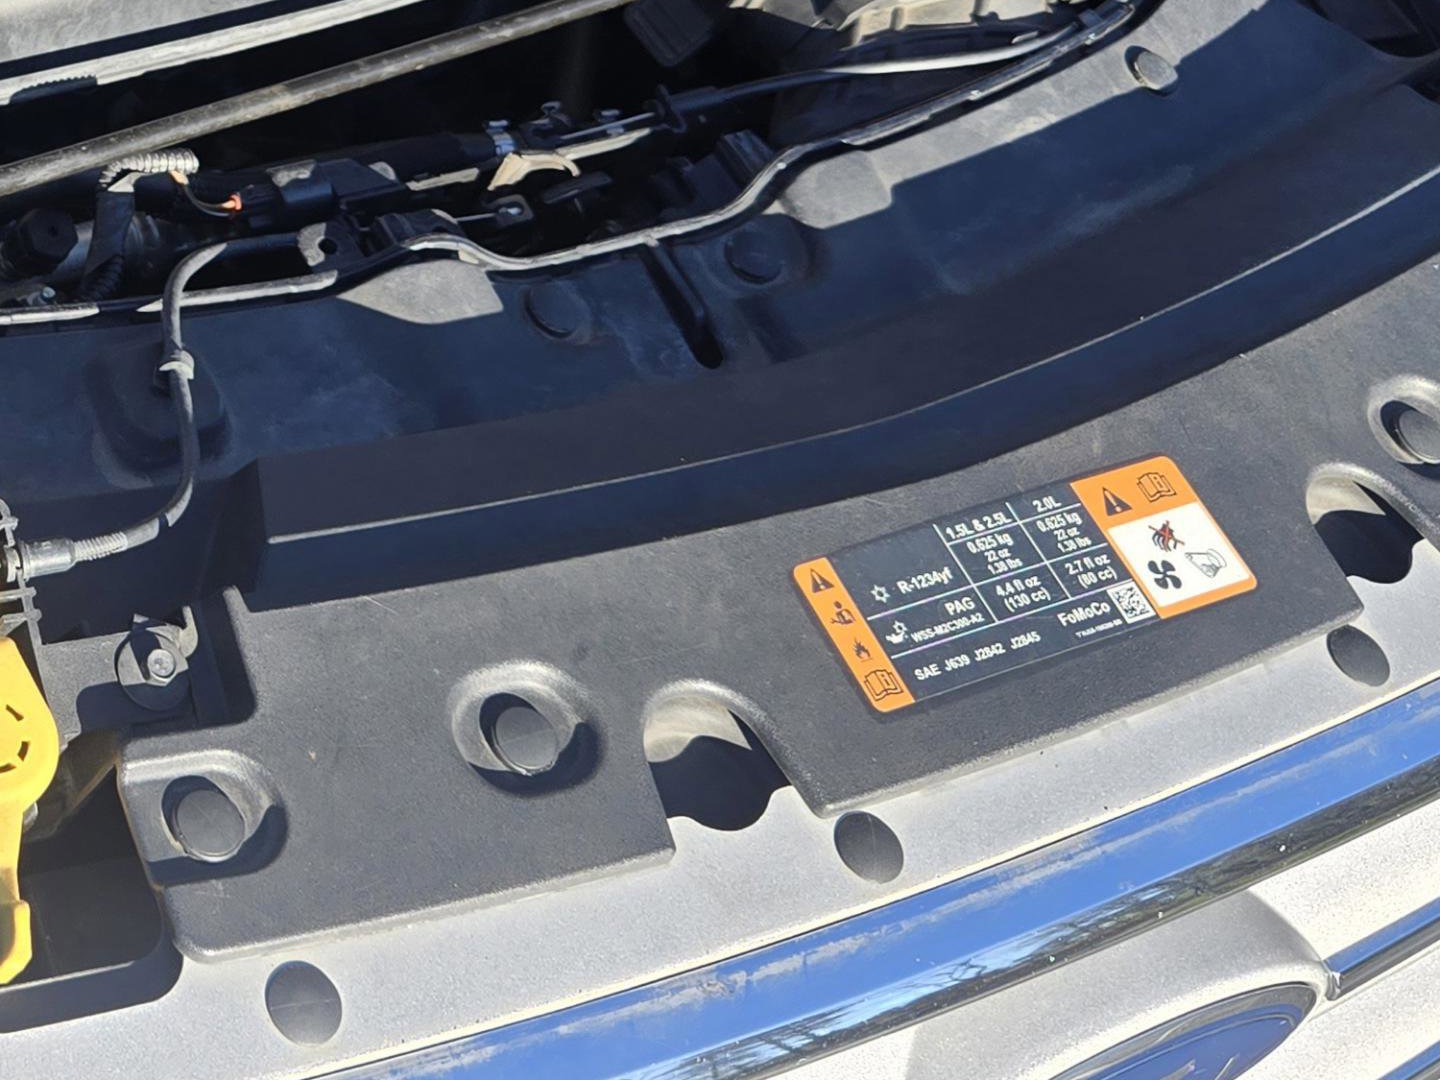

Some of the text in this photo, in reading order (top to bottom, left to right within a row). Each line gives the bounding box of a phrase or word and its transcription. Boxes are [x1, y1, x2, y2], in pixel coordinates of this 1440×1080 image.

[1032, 495, 1062, 512] 2.0L
[945, 512, 1013, 539] 1.5L & 2.5L
[1036, 512, 1082, 532] 0.625 kg
[966, 533, 1014, 554] 0.625 kg
[1065, 554, 1111, 575] 2.7 fl oz
[896, 566, 953, 594] R-1234yf
[995, 576, 1042, 597] 4.4 fl oz
[1077, 565, 1118, 589] (80 cc)
[944, 596, 975, 616] PAG
[1004, 586, 1051, 613] (130 cc)
[1057, 602, 1111, 627] FoMoCo
[914, 663, 942, 680] SAE
